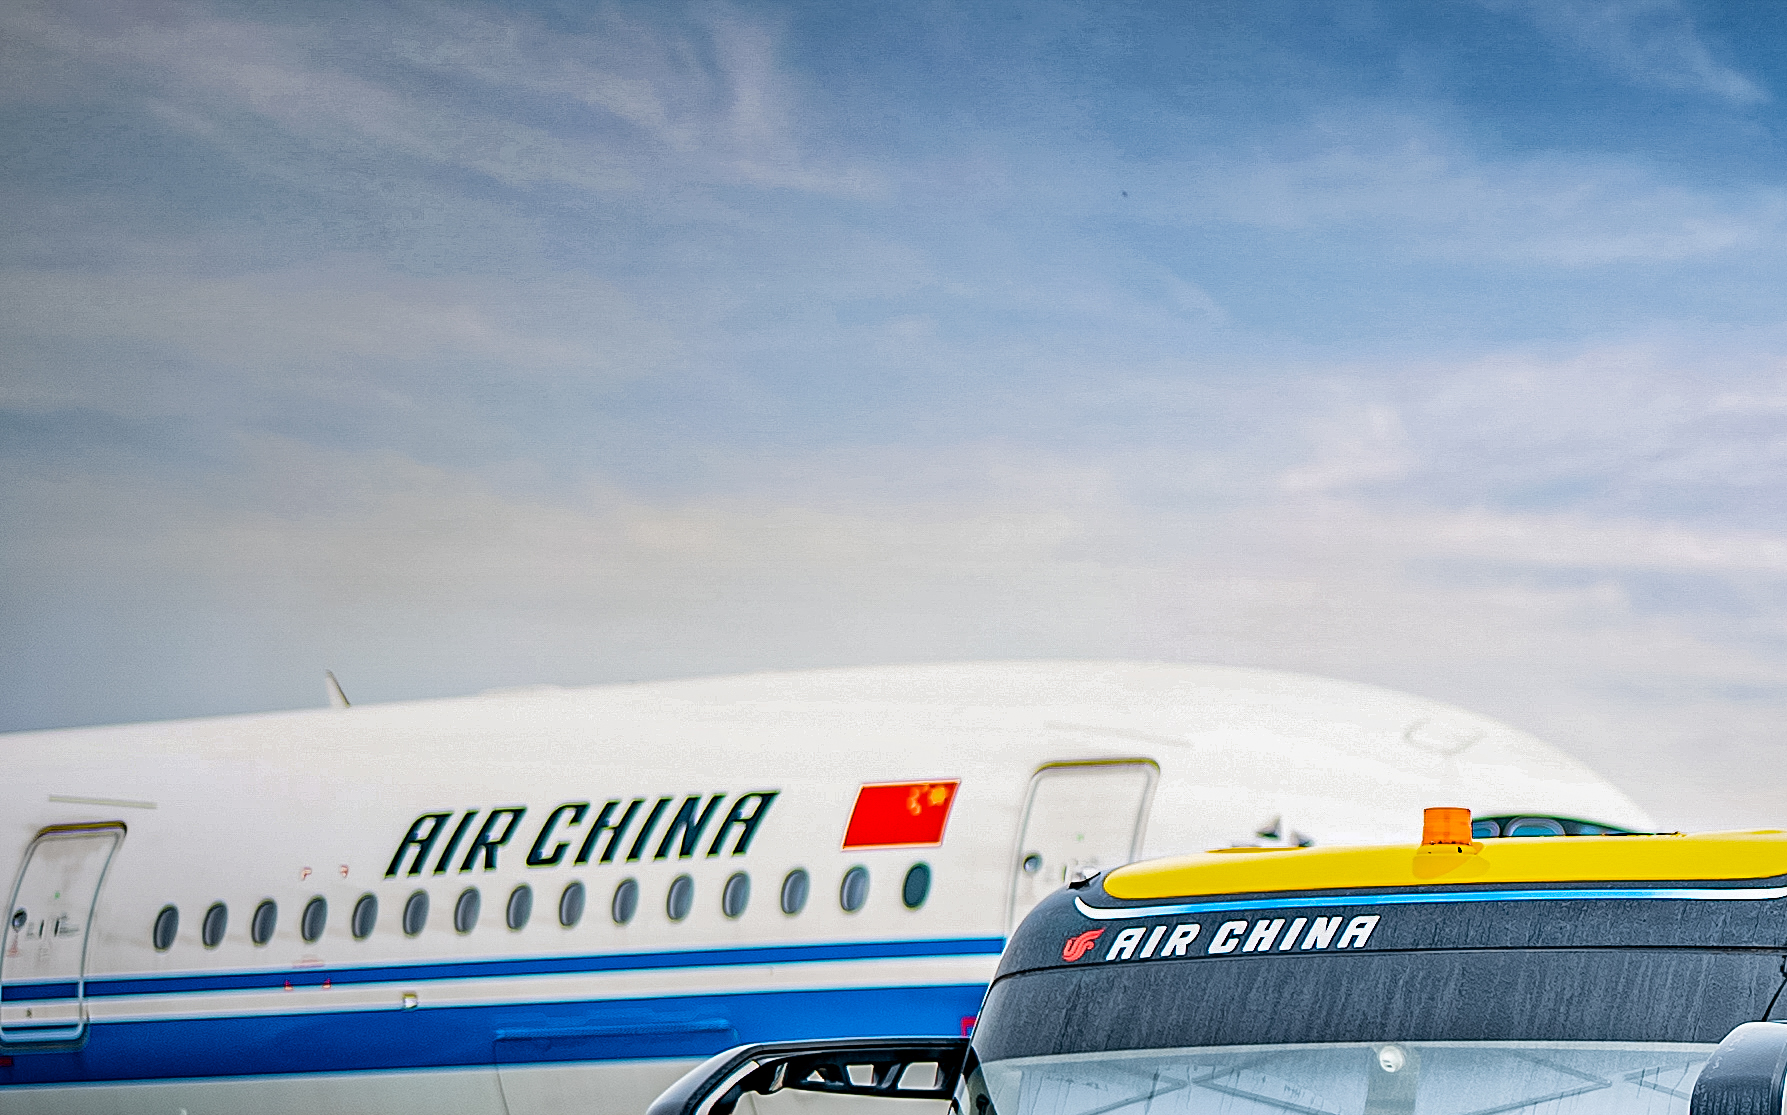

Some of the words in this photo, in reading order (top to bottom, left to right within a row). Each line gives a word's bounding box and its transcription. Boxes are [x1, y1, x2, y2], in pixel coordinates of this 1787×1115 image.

[385, 806, 526, 879] AIR
[527, 789, 781, 868] CHINA
[1106, 923, 1201, 961] AIR
[1207, 915, 1381, 955] CHINA
